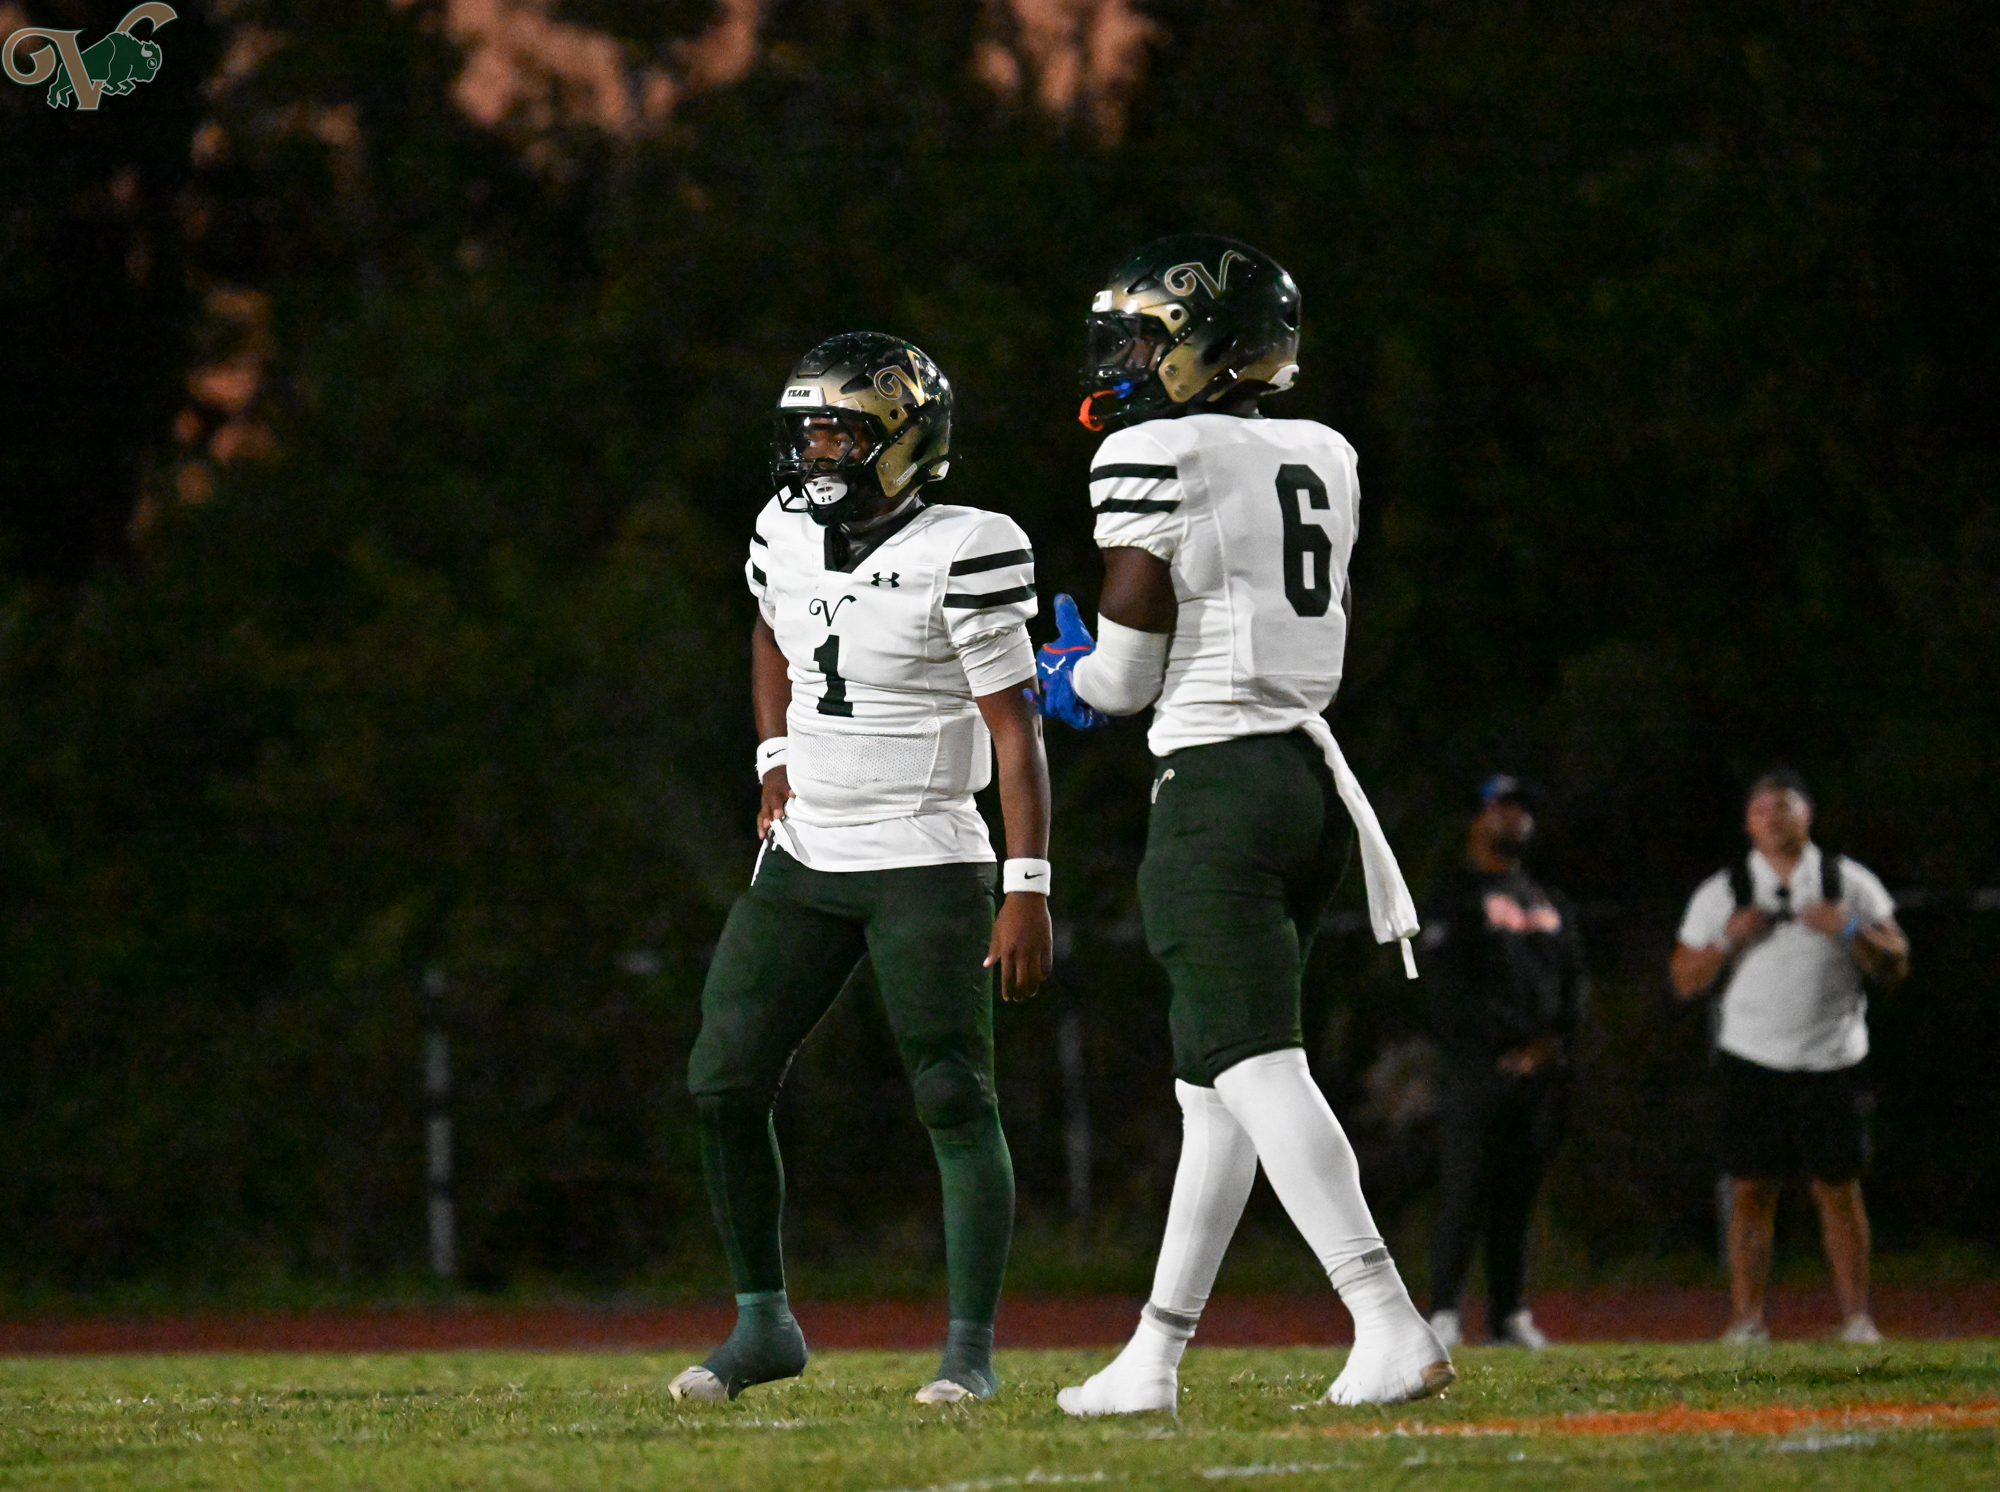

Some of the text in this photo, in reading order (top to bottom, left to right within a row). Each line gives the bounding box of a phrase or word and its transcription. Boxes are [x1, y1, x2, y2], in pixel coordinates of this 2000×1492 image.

[1164, 250, 1248, 300] V
[787, 389, 811, 398] TEAM
[873, 349, 926, 407] V
[1275, 464, 1332, 617] 6
[809, 595, 857, 627] V
[813, 634, 854, 718] 1
